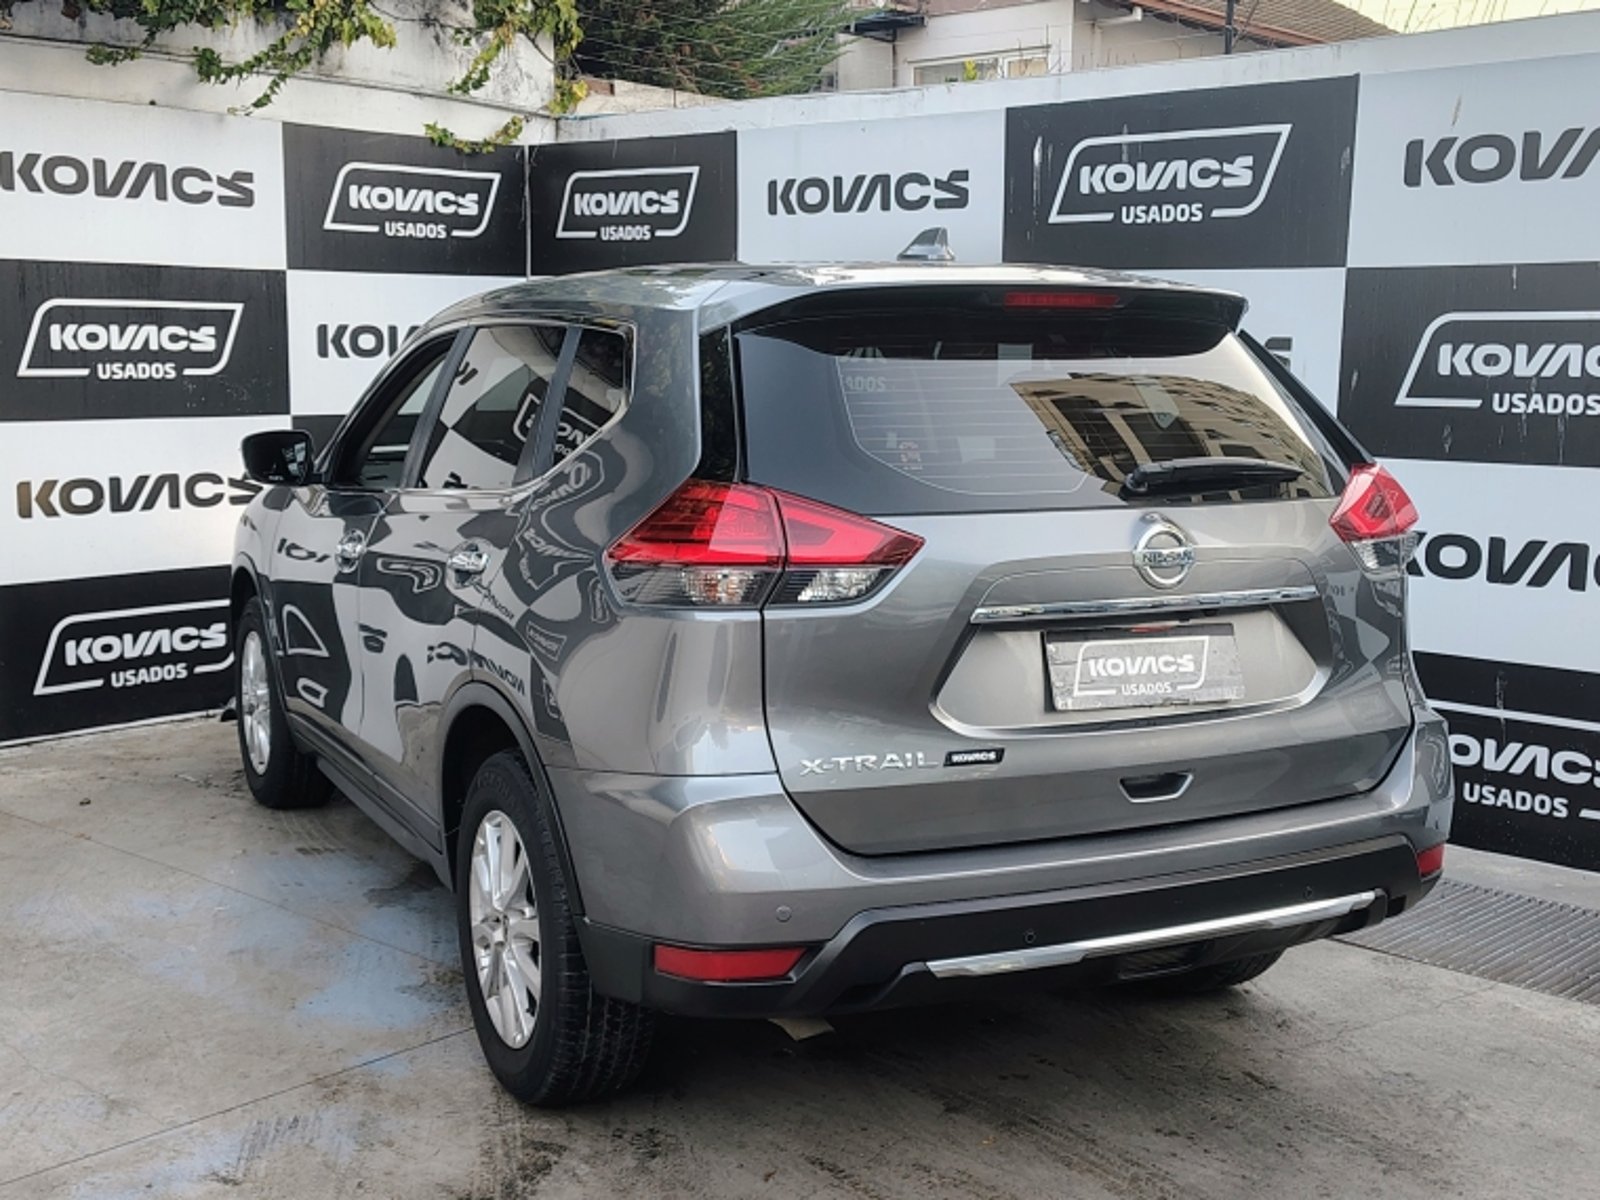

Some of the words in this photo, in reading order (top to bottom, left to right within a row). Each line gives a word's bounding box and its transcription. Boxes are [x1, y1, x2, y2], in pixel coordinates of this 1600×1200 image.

[0, 151, 255, 208] KOVACS
[1079, 155, 1254, 195] KOVACS
[348, 184, 480, 216] KOVACS
[573, 189, 680, 216] KOVACS
[768, 170, 969, 215] KOVACS
[1121, 203, 1204, 225] USADOS
[384, 221, 447, 240] USADOS
[600, 225, 652, 242] USADOS
[49, 323, 217, 352] KOVACS
[96, 363, 177, 380] USADOS
[1492, 392, 1600, 416] USADOS
[65, 622, 227, 666] KOVACS
[111, 663, 188, 688] USADOS
[1088, 654, 1196, 677] KOVACS
[1121, 682, 1173, 696] USADOS
[800, 751, 940, 776] X-TRAIL
[951, 752, 997, 763] KOVACS
[1463, 783, 1569, 818] USADOS
